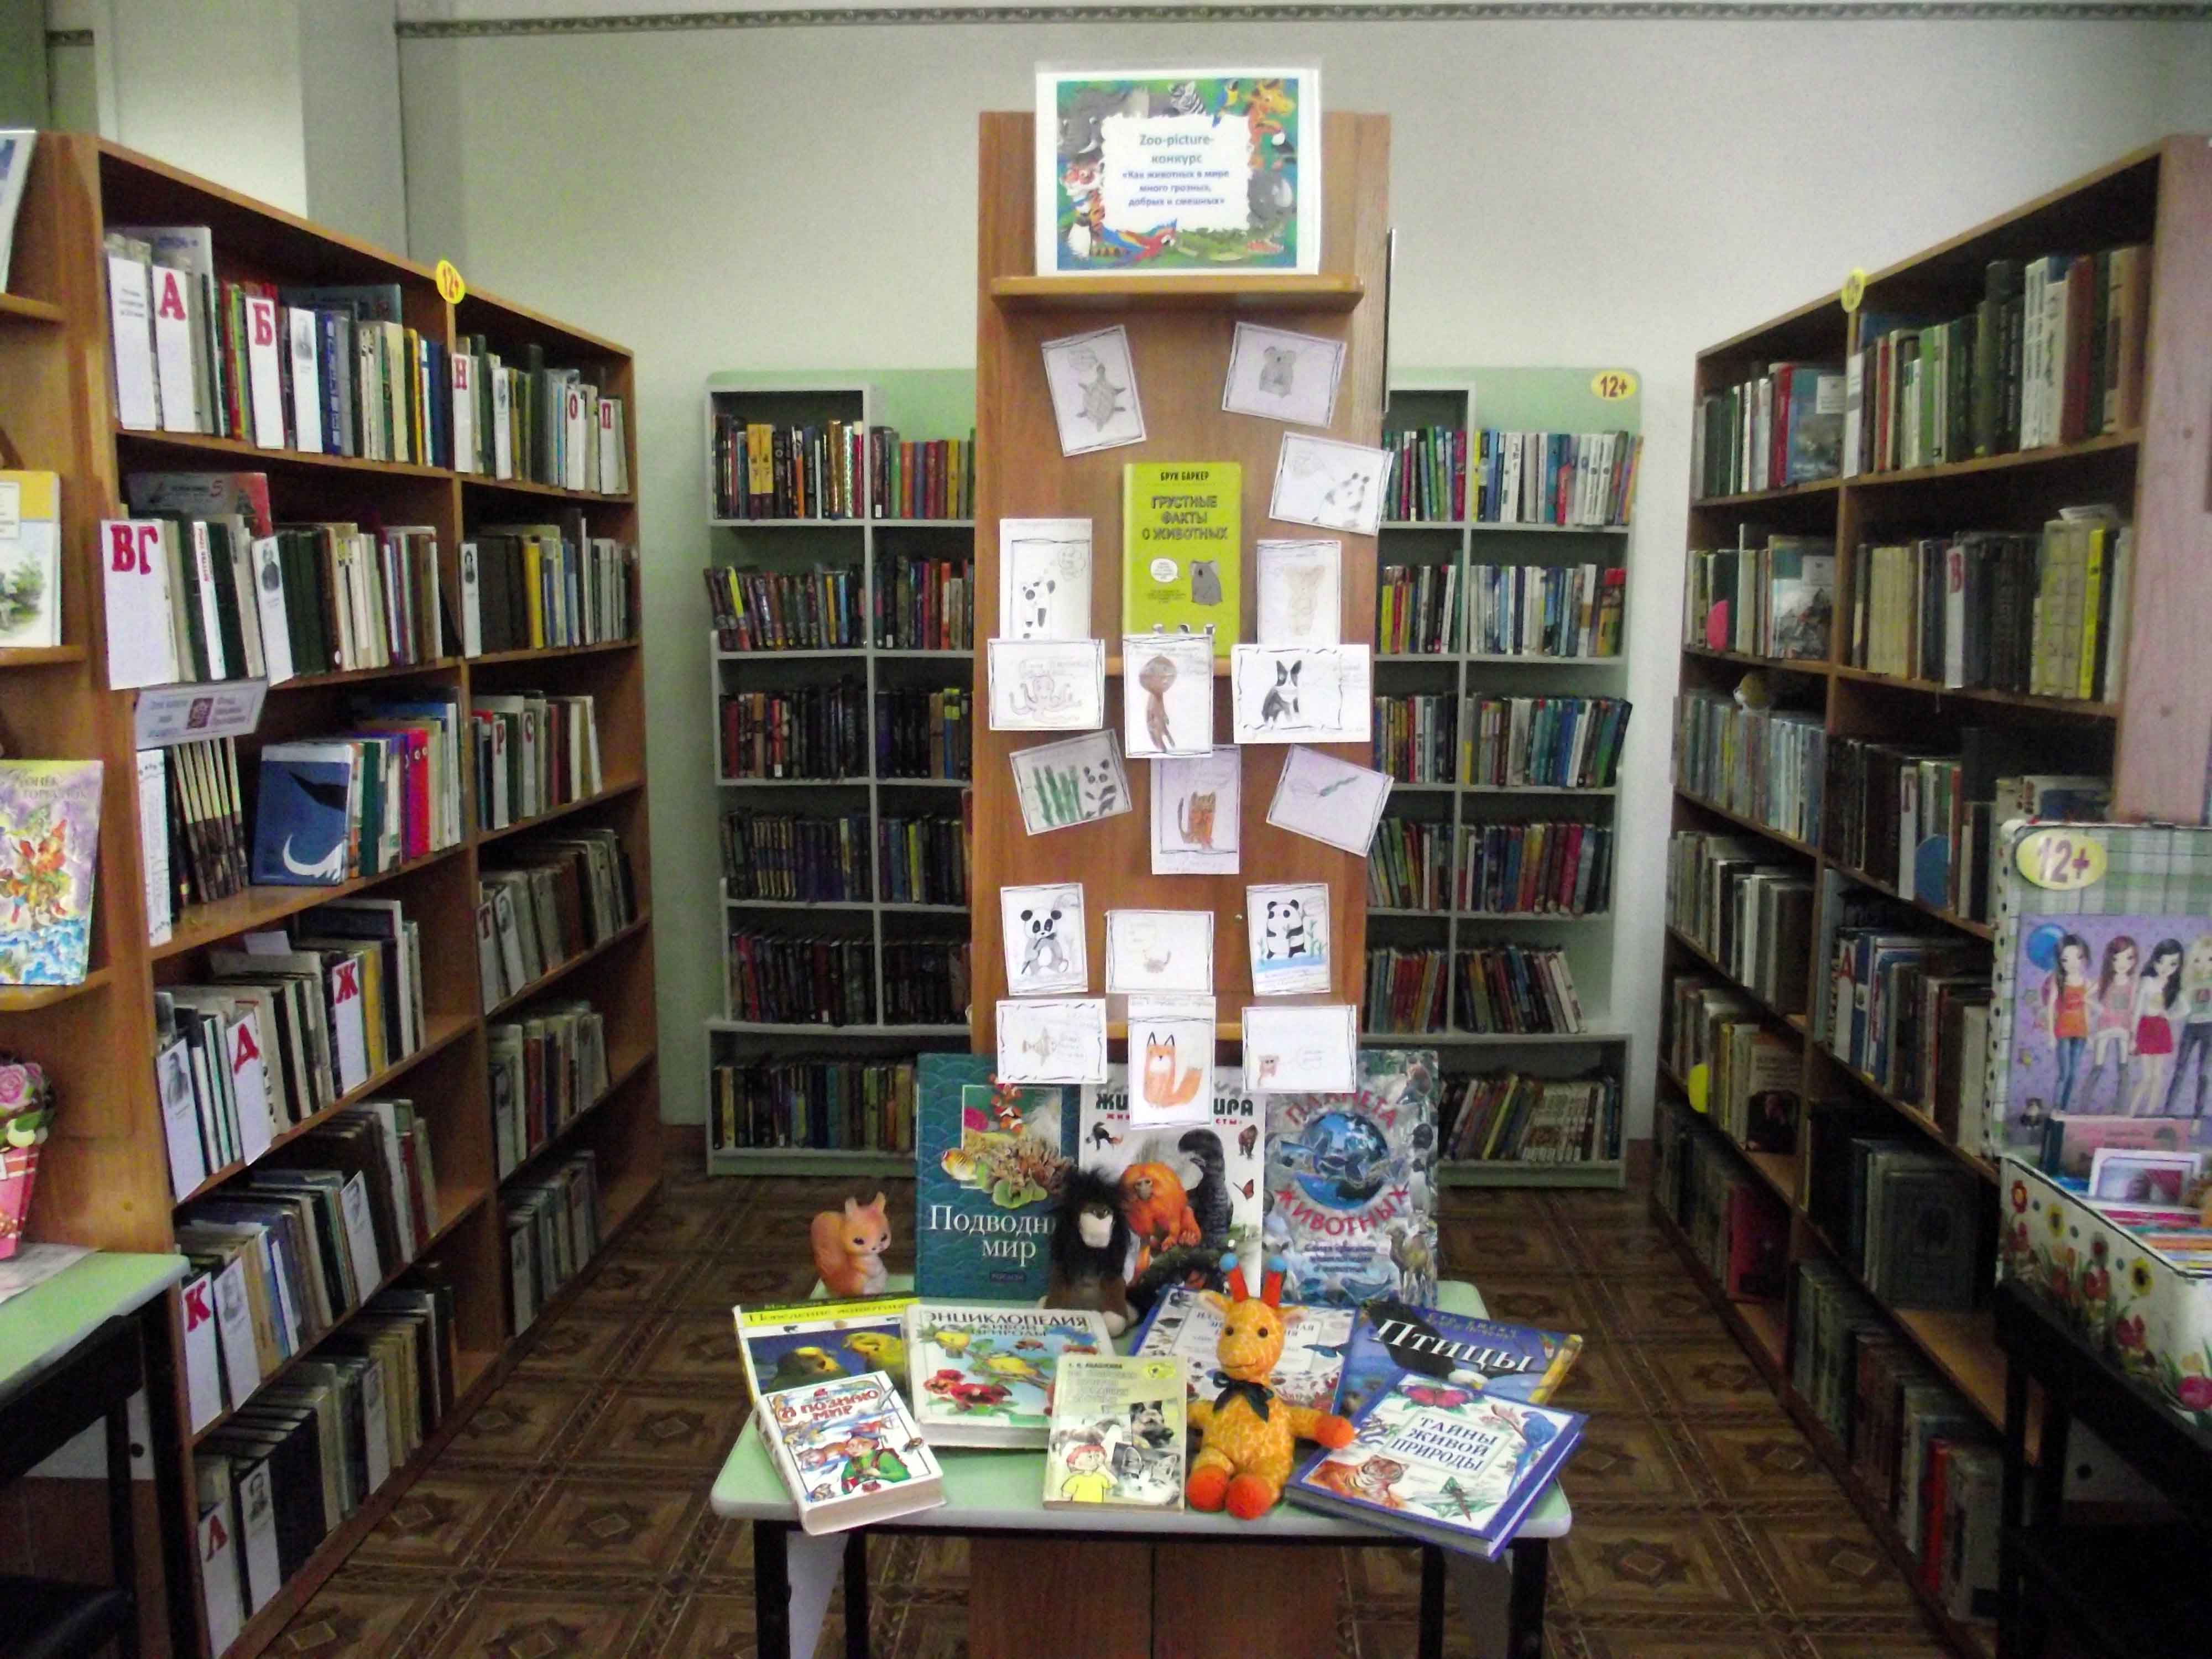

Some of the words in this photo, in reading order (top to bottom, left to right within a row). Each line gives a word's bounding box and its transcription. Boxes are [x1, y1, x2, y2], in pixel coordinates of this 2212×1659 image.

[1151, 155, 1202, 165] конкурс
[160, 272, 186, 320] А
[252, 302, 273, 346] Б
[1600, 375, 1627, 397] 12+
[1161, 471, 1178, 481] БРУК
[1181, 471, 1209, 481] БАРКЕР
[1151, 495, 1218, 509] ГРУСТНЫЕ
[1161, 511, 1207, 524] ФАКТЫ
[1142, 528, 1150, 540] О
[1153, 528, 1227, 540] ЖИВОТНЫХ
[2037, 837, 2090, 883] 12+
[336, 962, 358, 1004] Ж
[1213, 1098, 1253, 1116] ИРА
[929, 1204, 1050, 1236] Подводн
[1274, 1181, 1410, 1236] ЖИВОТНЫХ
[982, 1239, 1036, 1267] мир
[185, 1280, 211, 1332] К
[930, 1312, 1088, 1327] ЭНЦИКЛОПЕДИЯ
[1370, 1318, 1534, 1373] Птицы
[800, 1390, 879, 1413] ПОЗНАЮ
[813, 1405, 853, 1420] МИР
[1407, 1427, 1489, 1457] ЖИВОЙ
[1420, 1417, 1499, 1446] ТАЙНЫ
[1390, 1438, 1484, 1471] ПРИРОДЫ
